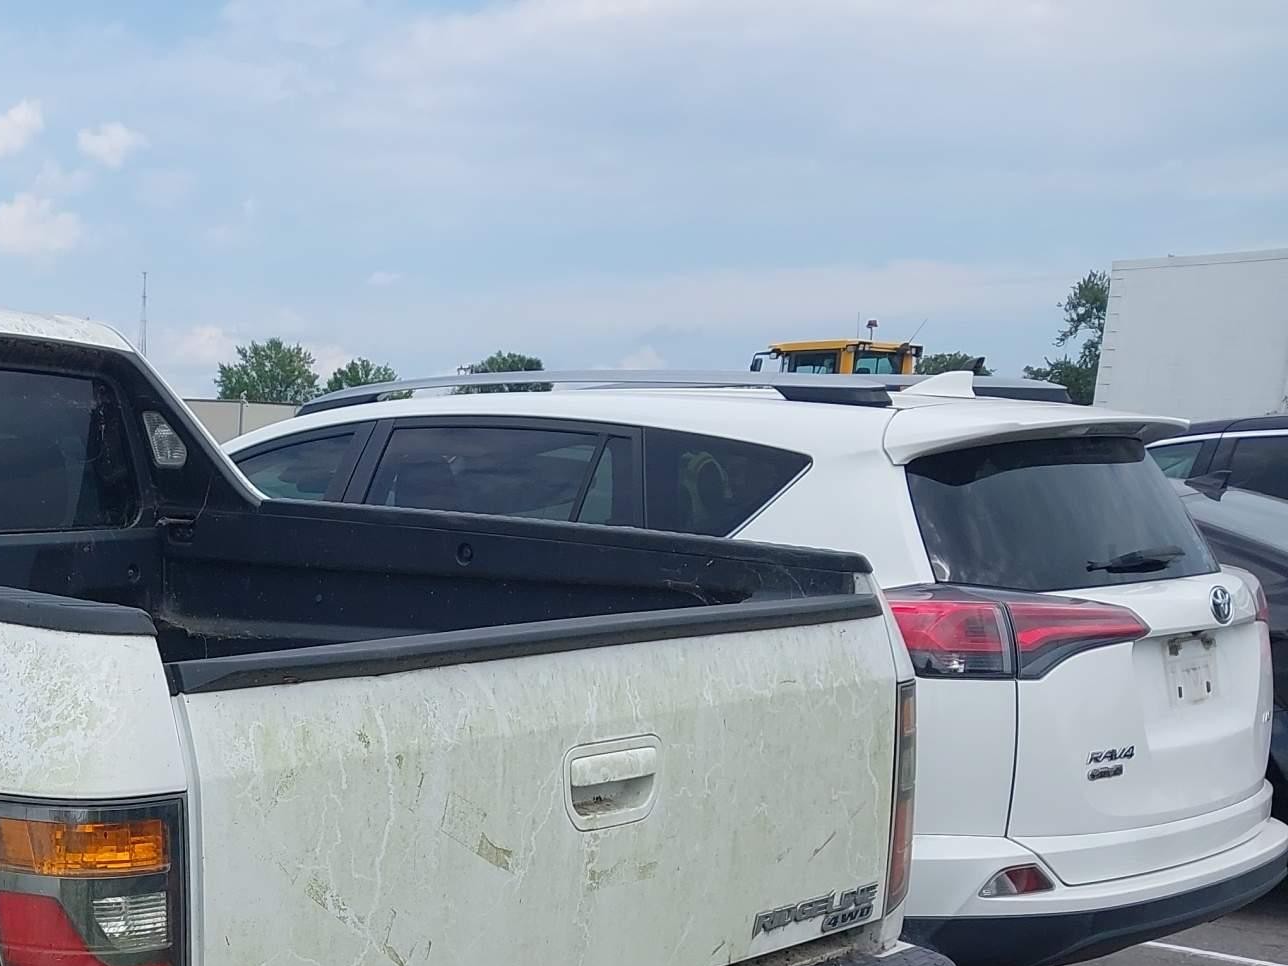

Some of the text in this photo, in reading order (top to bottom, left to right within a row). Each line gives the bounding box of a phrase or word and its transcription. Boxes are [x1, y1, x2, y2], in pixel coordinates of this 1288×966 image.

[1087, 744, 1135, 765] RAV4
[751, 880, 879, 940] RIDGELINE
[826, 904, 872, 928] 4WD
